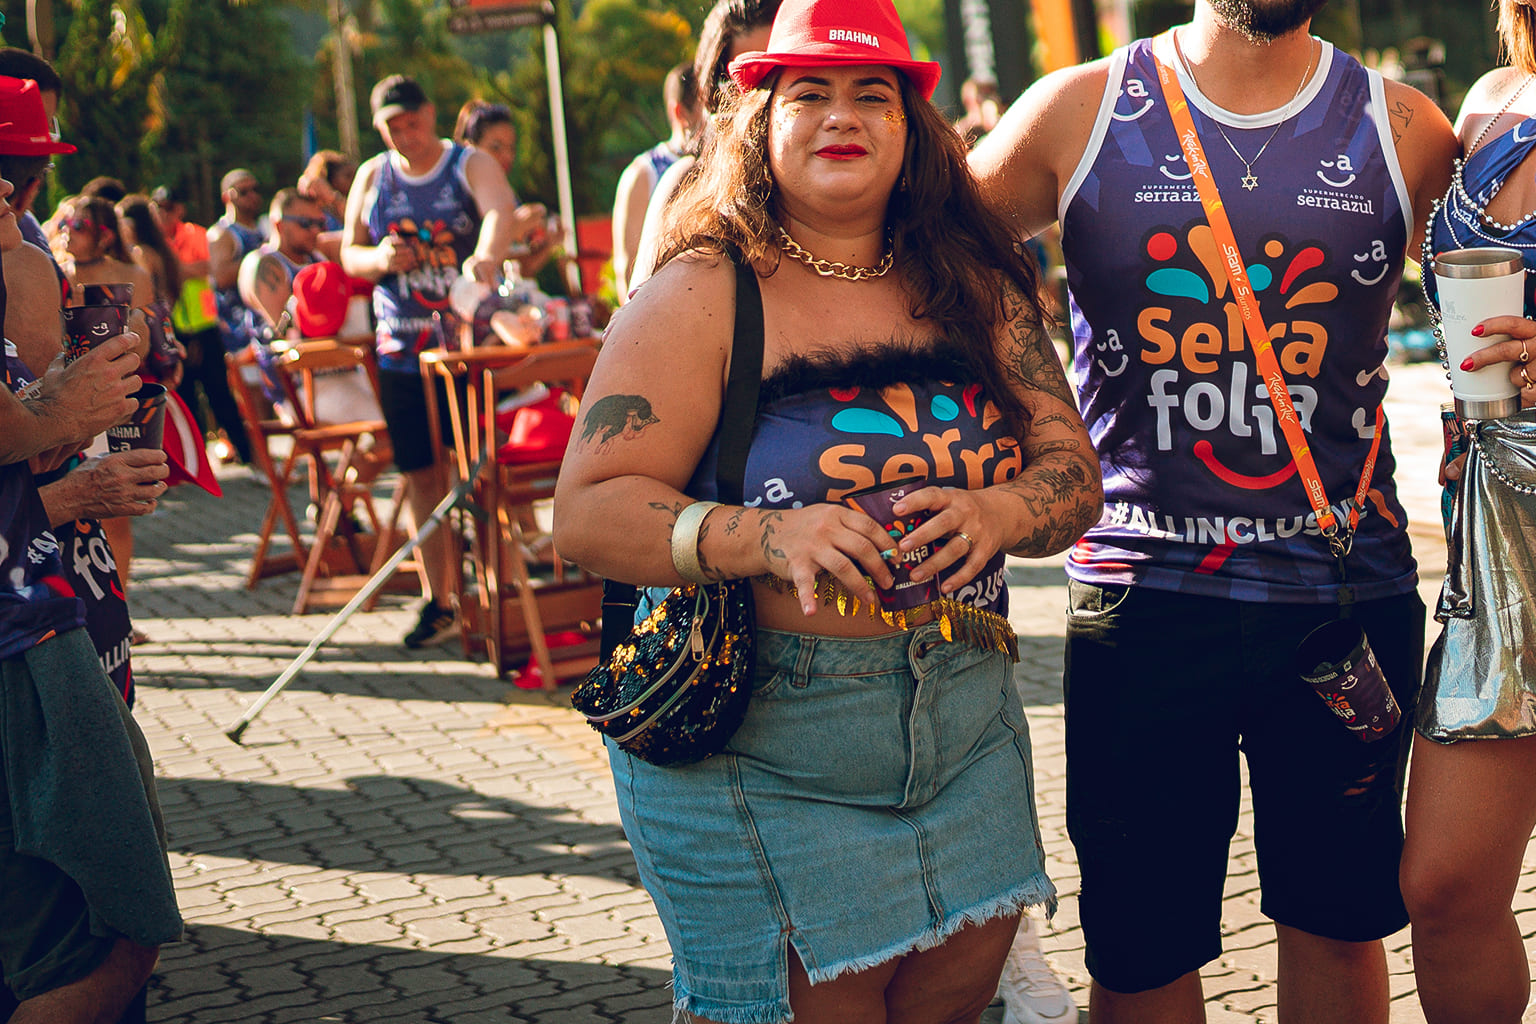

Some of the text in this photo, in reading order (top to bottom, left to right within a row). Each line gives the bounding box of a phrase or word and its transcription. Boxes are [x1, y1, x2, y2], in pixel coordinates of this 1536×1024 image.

[828, 29, 880, 48] BRAHMA
[1134, 190, 1202, 203] serraaz
[1297, 193, 1374, 215] serraazul
[1303, 188, 1364, 200] SUPERMERCADO
[1137, 301, 1329, 379] serra
[1147, 361, 1318, 456] folia
[108, 426, 141, 438] AHMA
[818, 427, 1022, 503] serra
[1110, 497, 1368, 545] #ALLINCLUSVE
